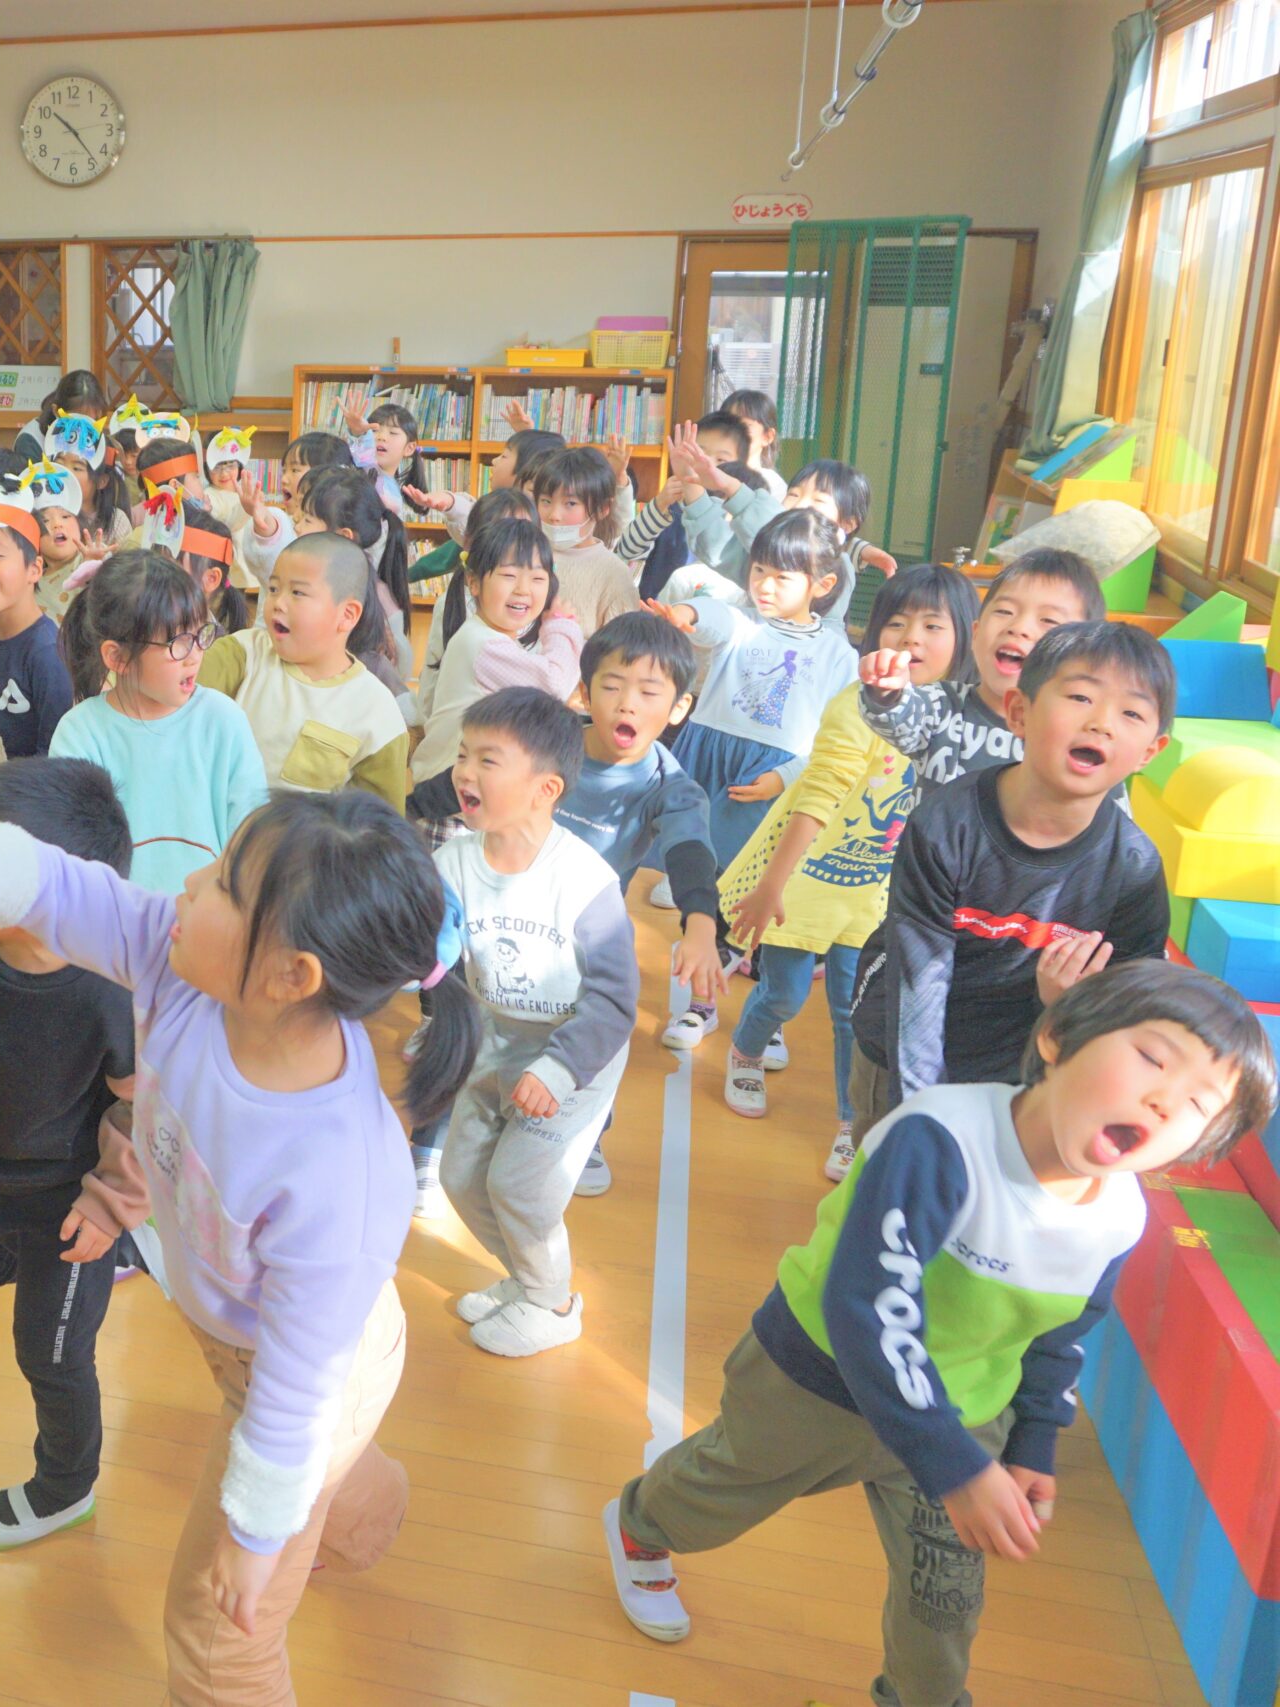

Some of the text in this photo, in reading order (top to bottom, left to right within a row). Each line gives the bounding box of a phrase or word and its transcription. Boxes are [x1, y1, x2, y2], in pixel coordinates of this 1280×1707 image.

[52, 91, 61, 104] 11
[67, 86, 80, 99] 12
[88, 90, 93, 104] 1
[38, 106, 51, 119] 10
[100, 103, 108, 117] 2
[33, 125, 42, 138] 9
[106, 123, 114, 137] 3
[39, 144, 47, 157] 8
[100, 143, 108, 156] 4
[52, 158, 60, 171] 7
[70, 162, 78, 176] 6
[88, 157, 96, 171] 5
[492, 916, 567, 949] SCOOTER
[515, 998, 525, 1010] IS
[530, 1000, 576, 1015] ENDLESS
[957, 1243, 1010, 1273] crocs
[874, 1208, 937, 1410] crocs
